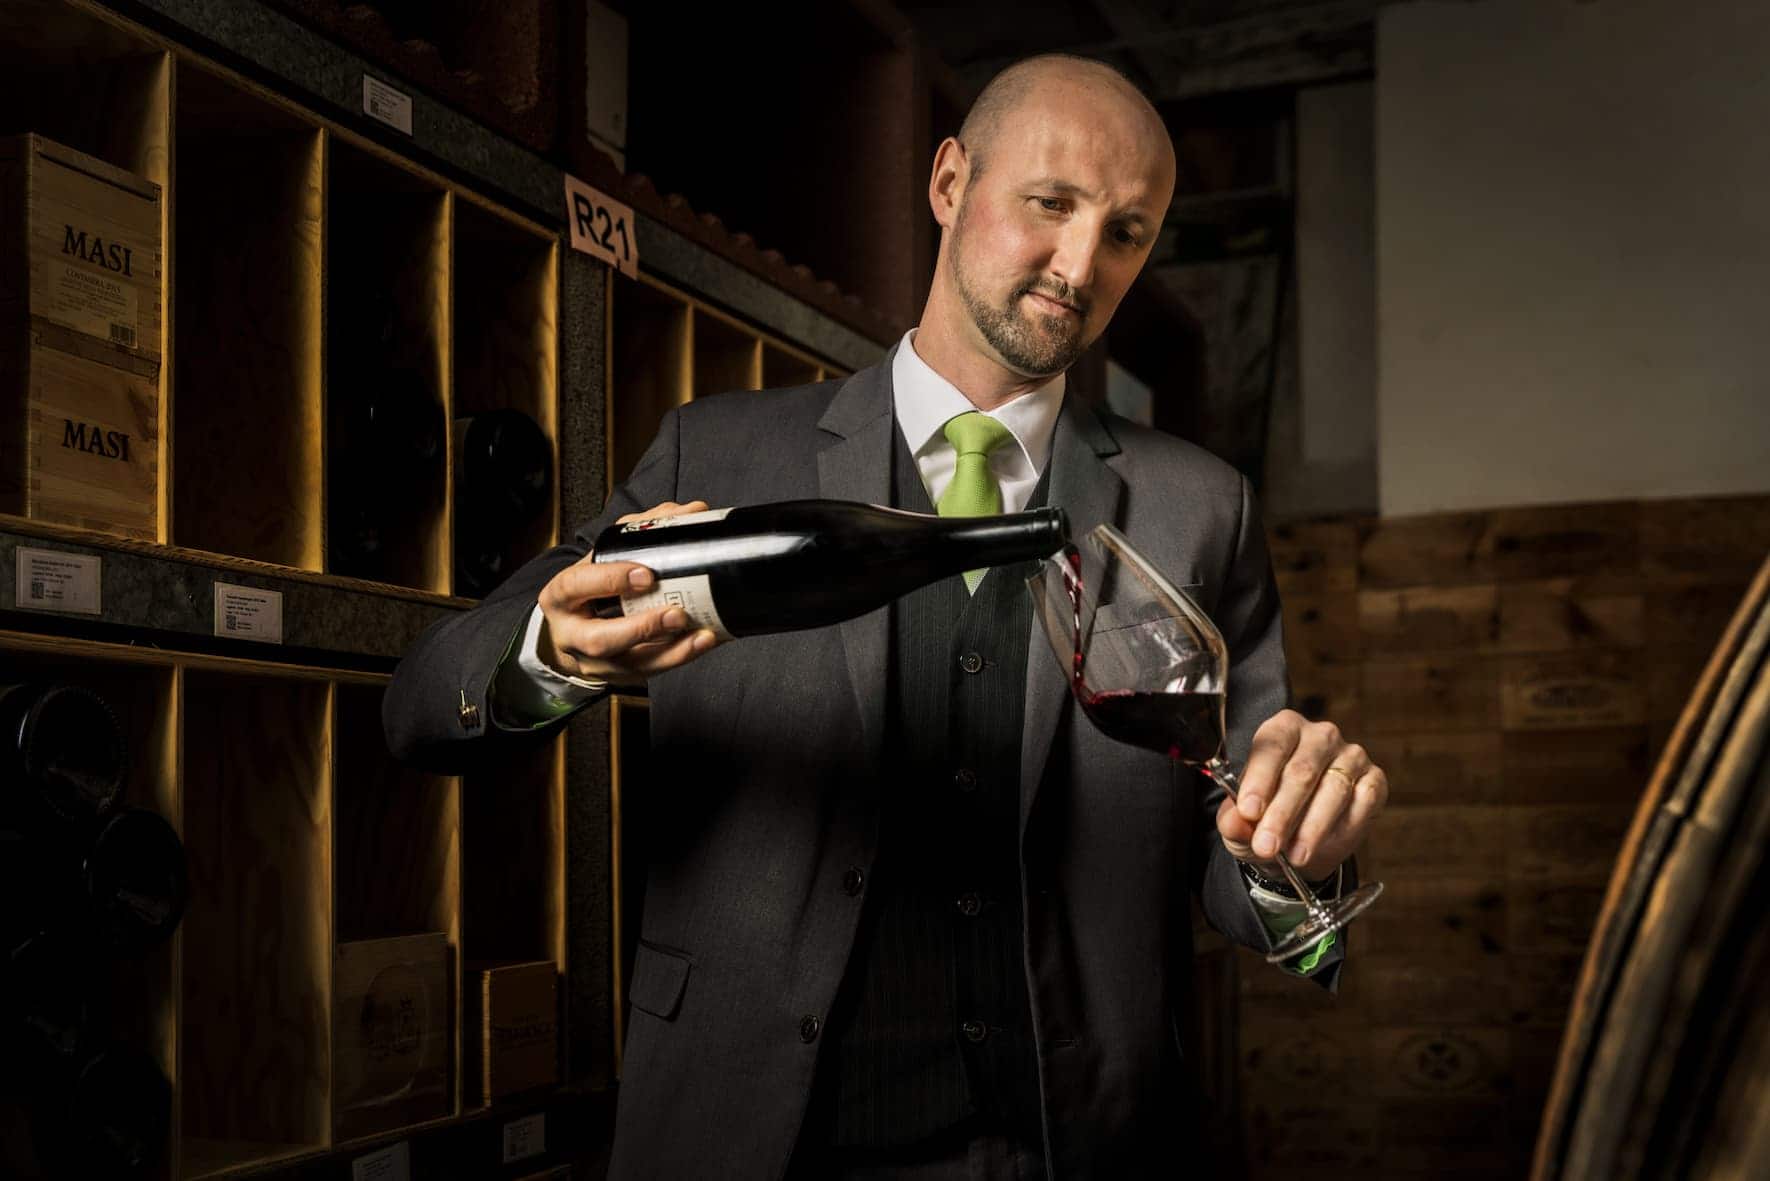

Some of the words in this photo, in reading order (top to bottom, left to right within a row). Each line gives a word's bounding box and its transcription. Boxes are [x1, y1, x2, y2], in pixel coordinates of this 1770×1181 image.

[62, 224, 132, 277] MASI
[573, 191, 630, 261] R21
[62, 419, 131, 463] MASI
